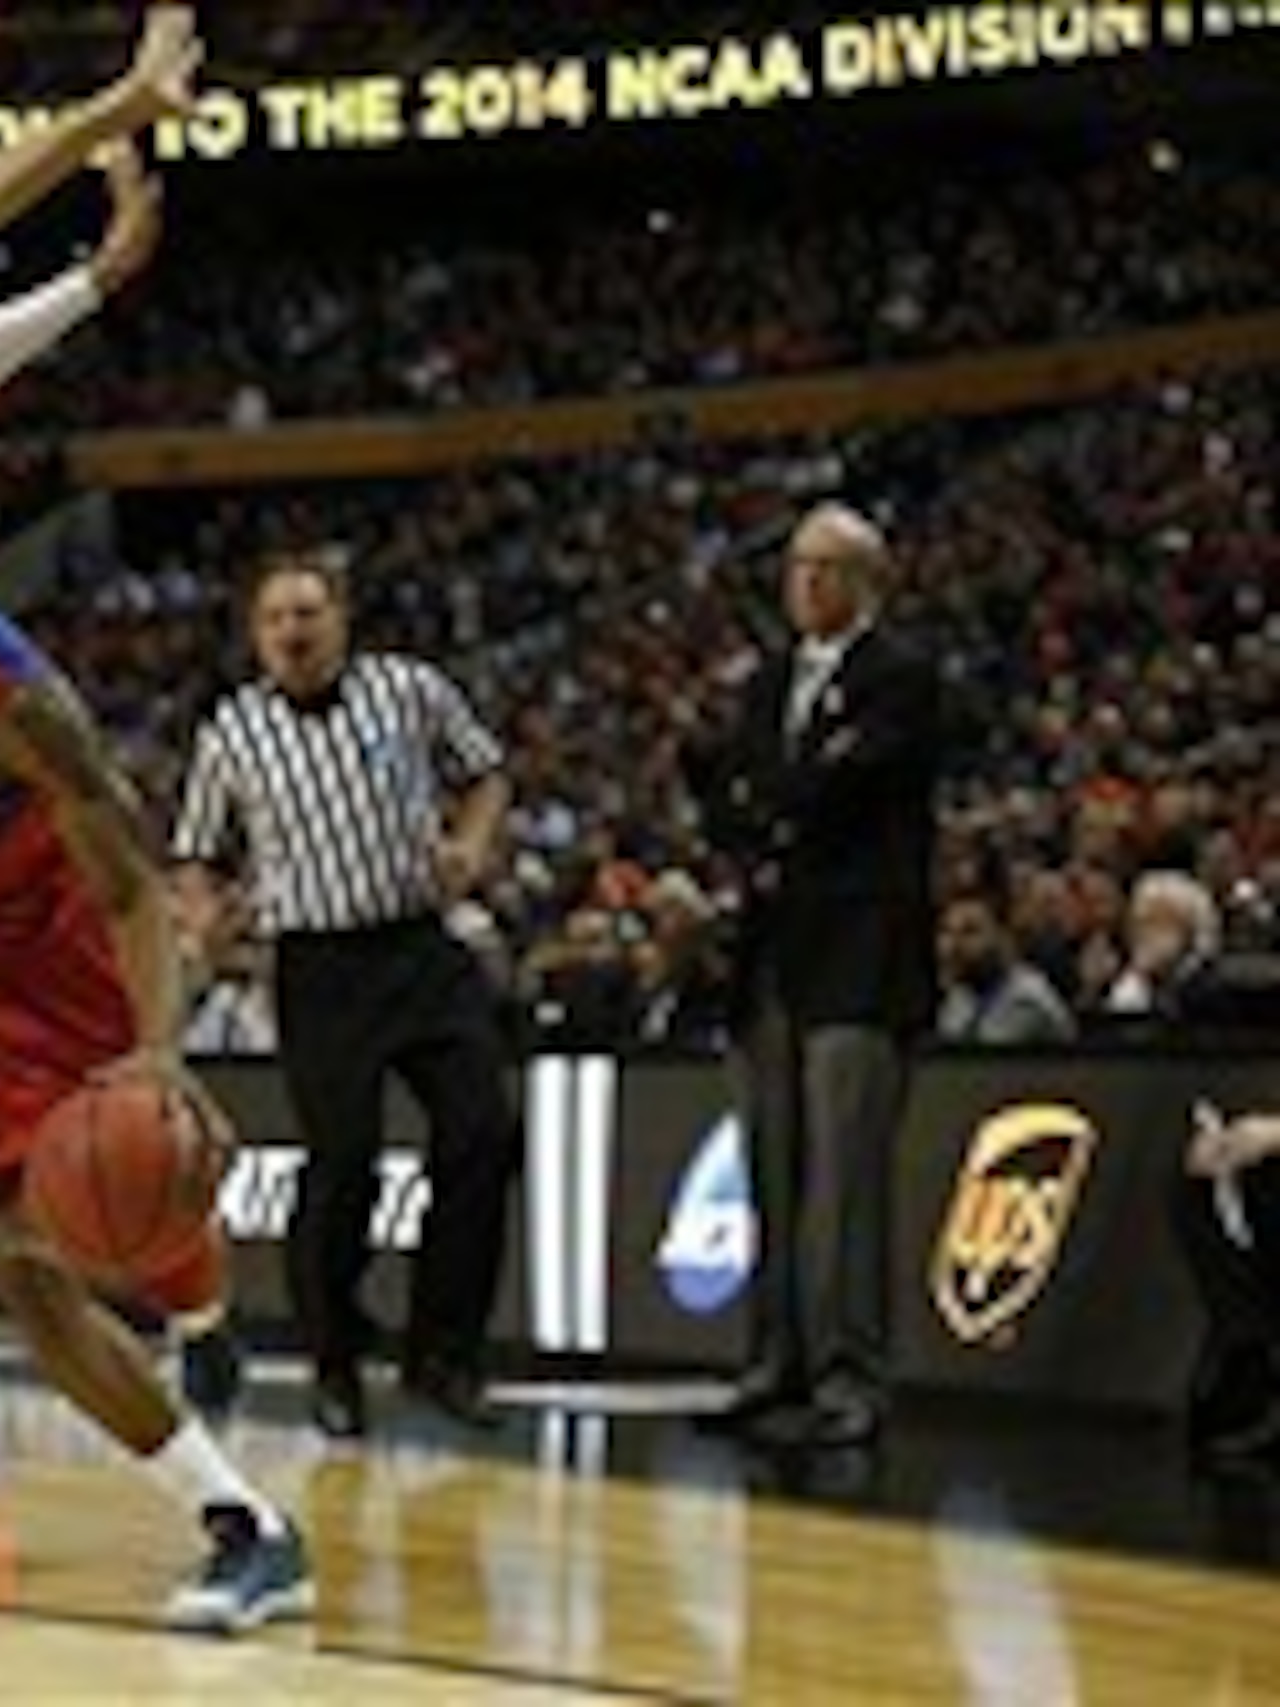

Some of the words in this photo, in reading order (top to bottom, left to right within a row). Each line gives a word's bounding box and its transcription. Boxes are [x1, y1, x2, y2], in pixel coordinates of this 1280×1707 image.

[259, 74, 404, 149] THE
[418, 55, 590, 139] 2014
[607, 33, 813, 121] NCAA
[821, 0, 1149, 95] DIVISION
